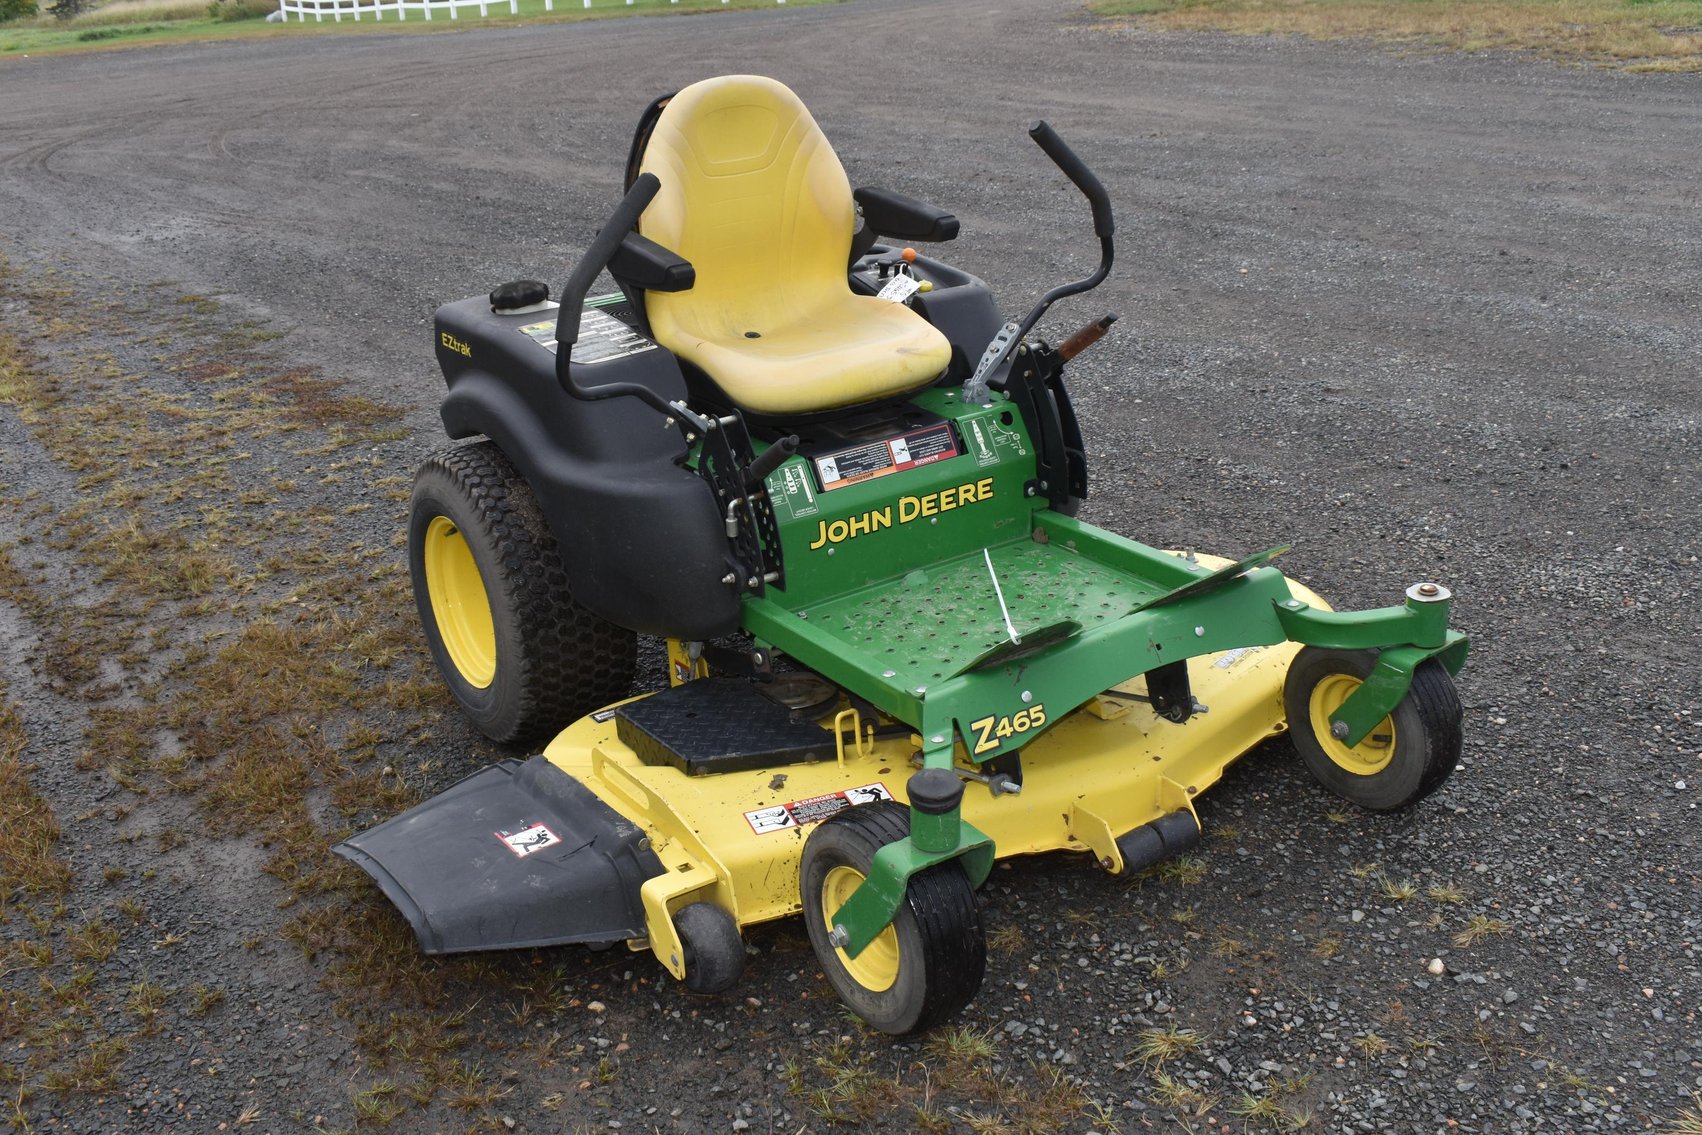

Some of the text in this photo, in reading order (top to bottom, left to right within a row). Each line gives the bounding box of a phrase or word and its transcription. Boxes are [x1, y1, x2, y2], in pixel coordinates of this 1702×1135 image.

[441, 332, 472, 358] EZtrak
[913, 455, 936, 466] DANGER
[810, 477, 994, 550] JOHN DEERE
[970, 704, 1046, 755] Z465
[801, 793, 837, 805] DANGER
